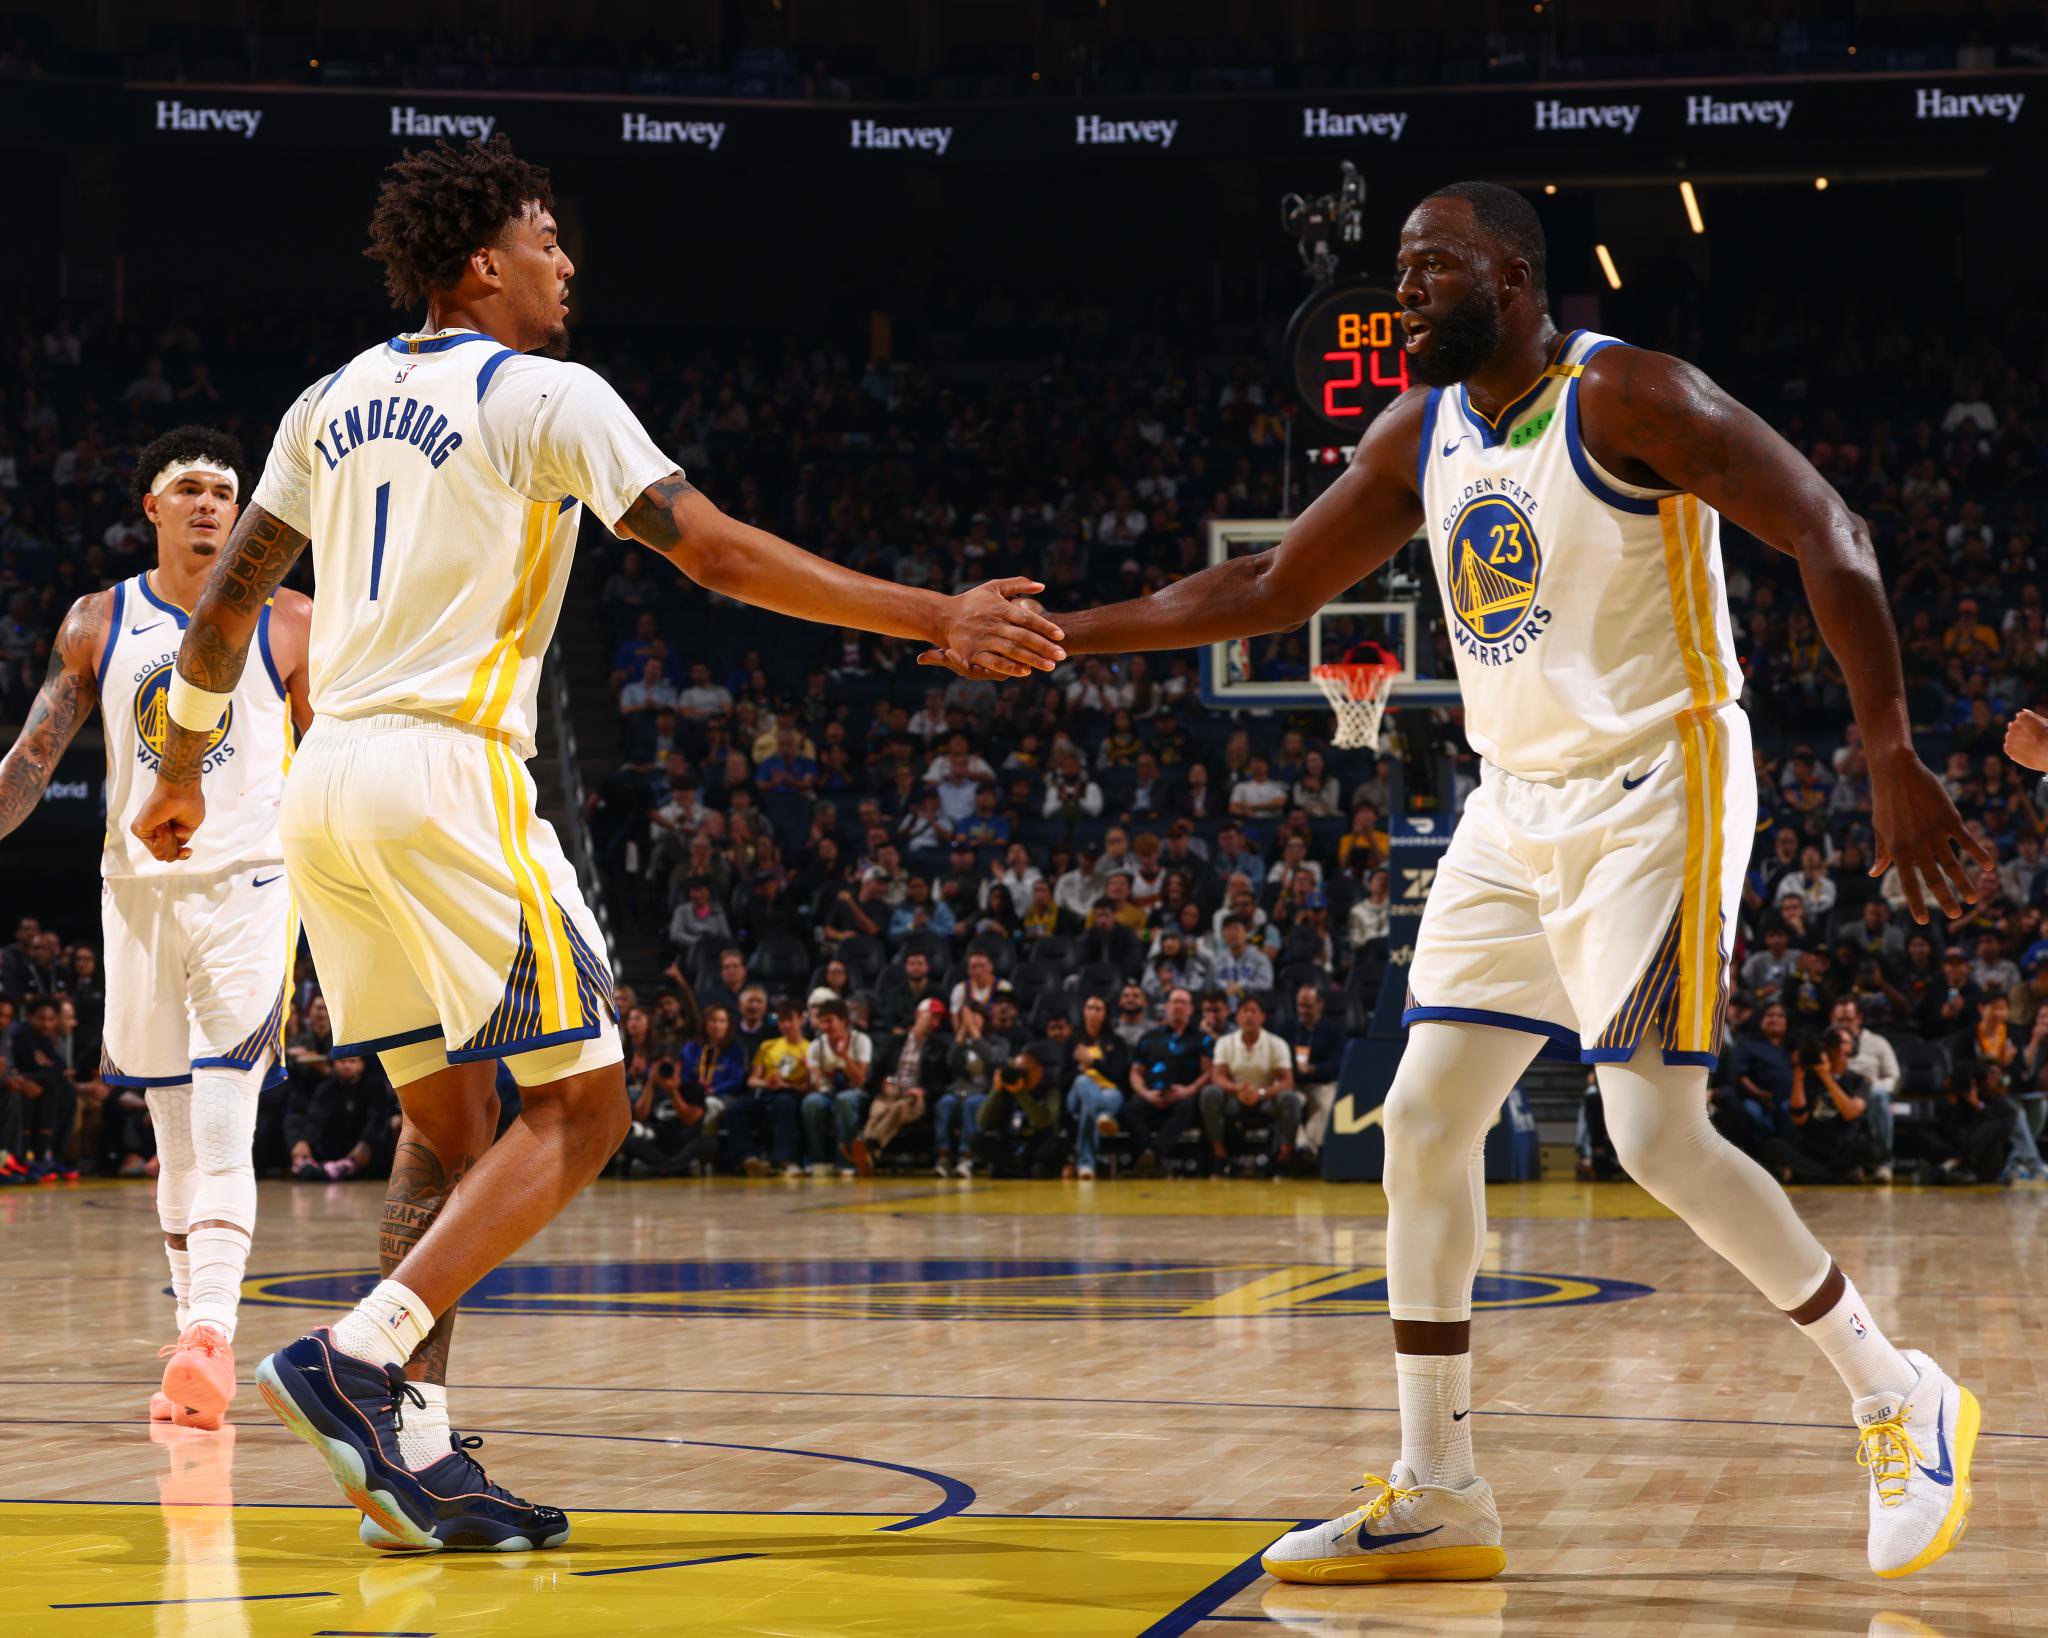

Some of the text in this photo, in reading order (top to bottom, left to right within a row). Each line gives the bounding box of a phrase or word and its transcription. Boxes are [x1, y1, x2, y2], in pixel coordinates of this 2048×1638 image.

[158, 101, 260, 137] Harvey
[1537, 101, 1639, 132] Harvey
[1688, 96, 1791, 128] Harvey
[1918, 90, 2022, 121] Harvey
[392, 107, 493, 142] Harvey
[624, 114, 723, 148] Harvey
[852, 120, 951, 153] Harvey
[1077, 116, 1176, 146] Harvey
[1305, 109, 1405, 139] Harvey
[1338, 312, 1403, 349] 8:0
[1323, 350, 1409, 417] 24
[314, 396, 463, 472] LENDEBORG
[1443, 477, 1539, 532] GOLDEN STATE
[369, 480, 391, 601] 1
[1489, 522, 1523, 565] 23
[1453, 604, 1553, 667] WARRIORS
[133, 650, 179, 684] GOLDE
[136, 742, 236, 775] WAORS
